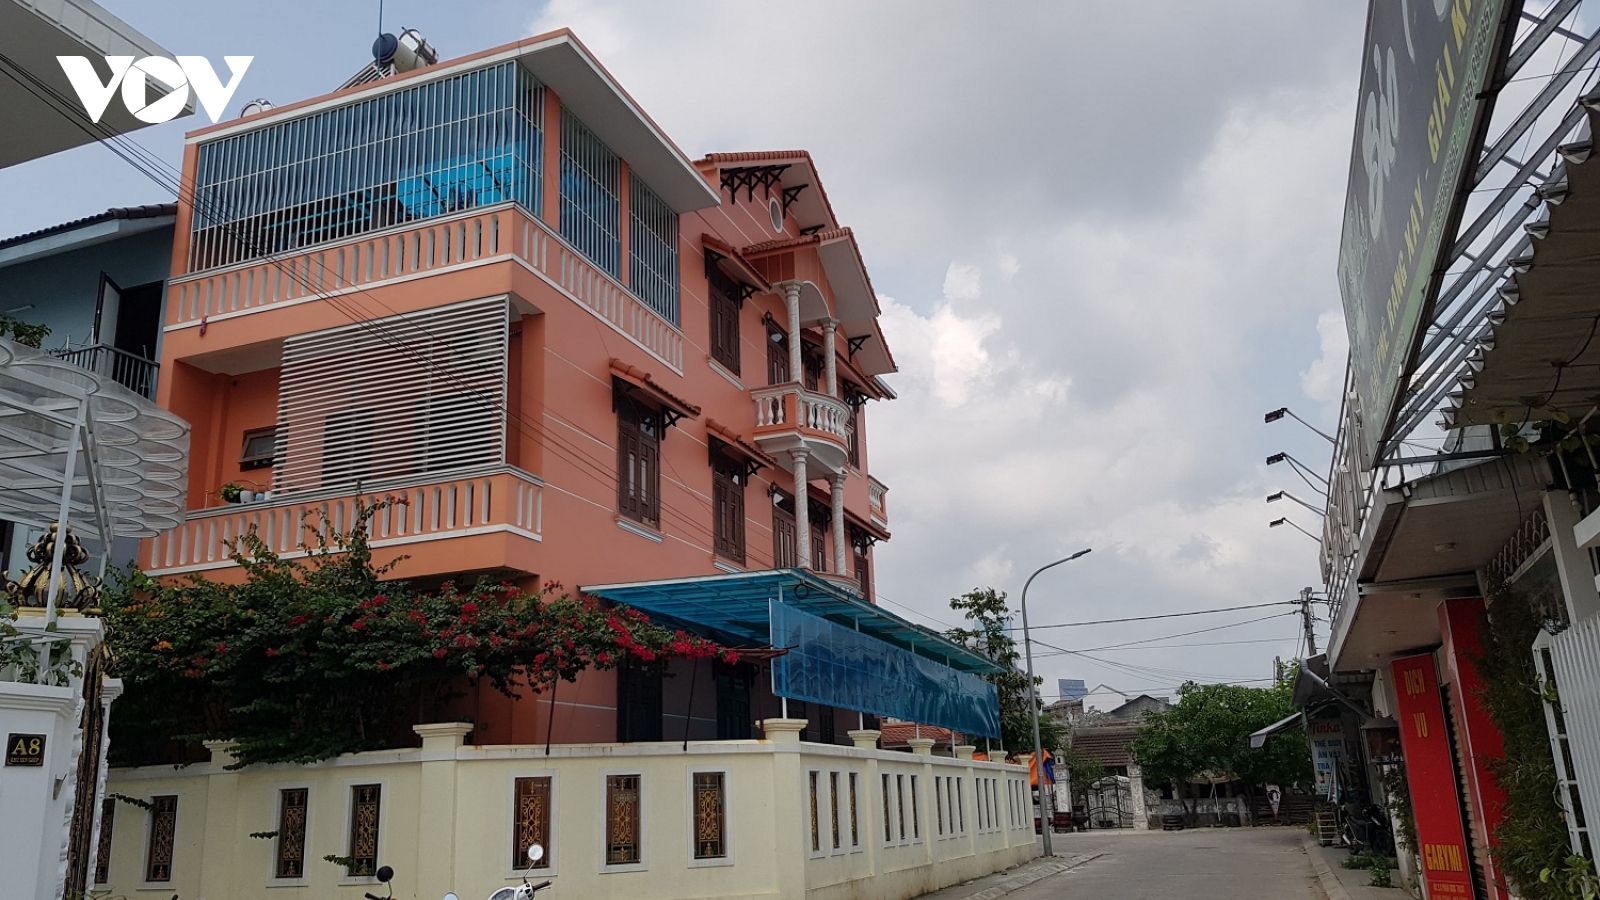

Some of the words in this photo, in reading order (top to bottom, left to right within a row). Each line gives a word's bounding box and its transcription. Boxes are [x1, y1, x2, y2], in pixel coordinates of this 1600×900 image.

[1386, 250, 1408, 333] RANG
[1404, 175, 1425, 265] XAY
[1427, 41, 1455, 164] GIẢI
[11, 738, 41, 756] A8
[1424, 843, 1464, 872] GARYMI
